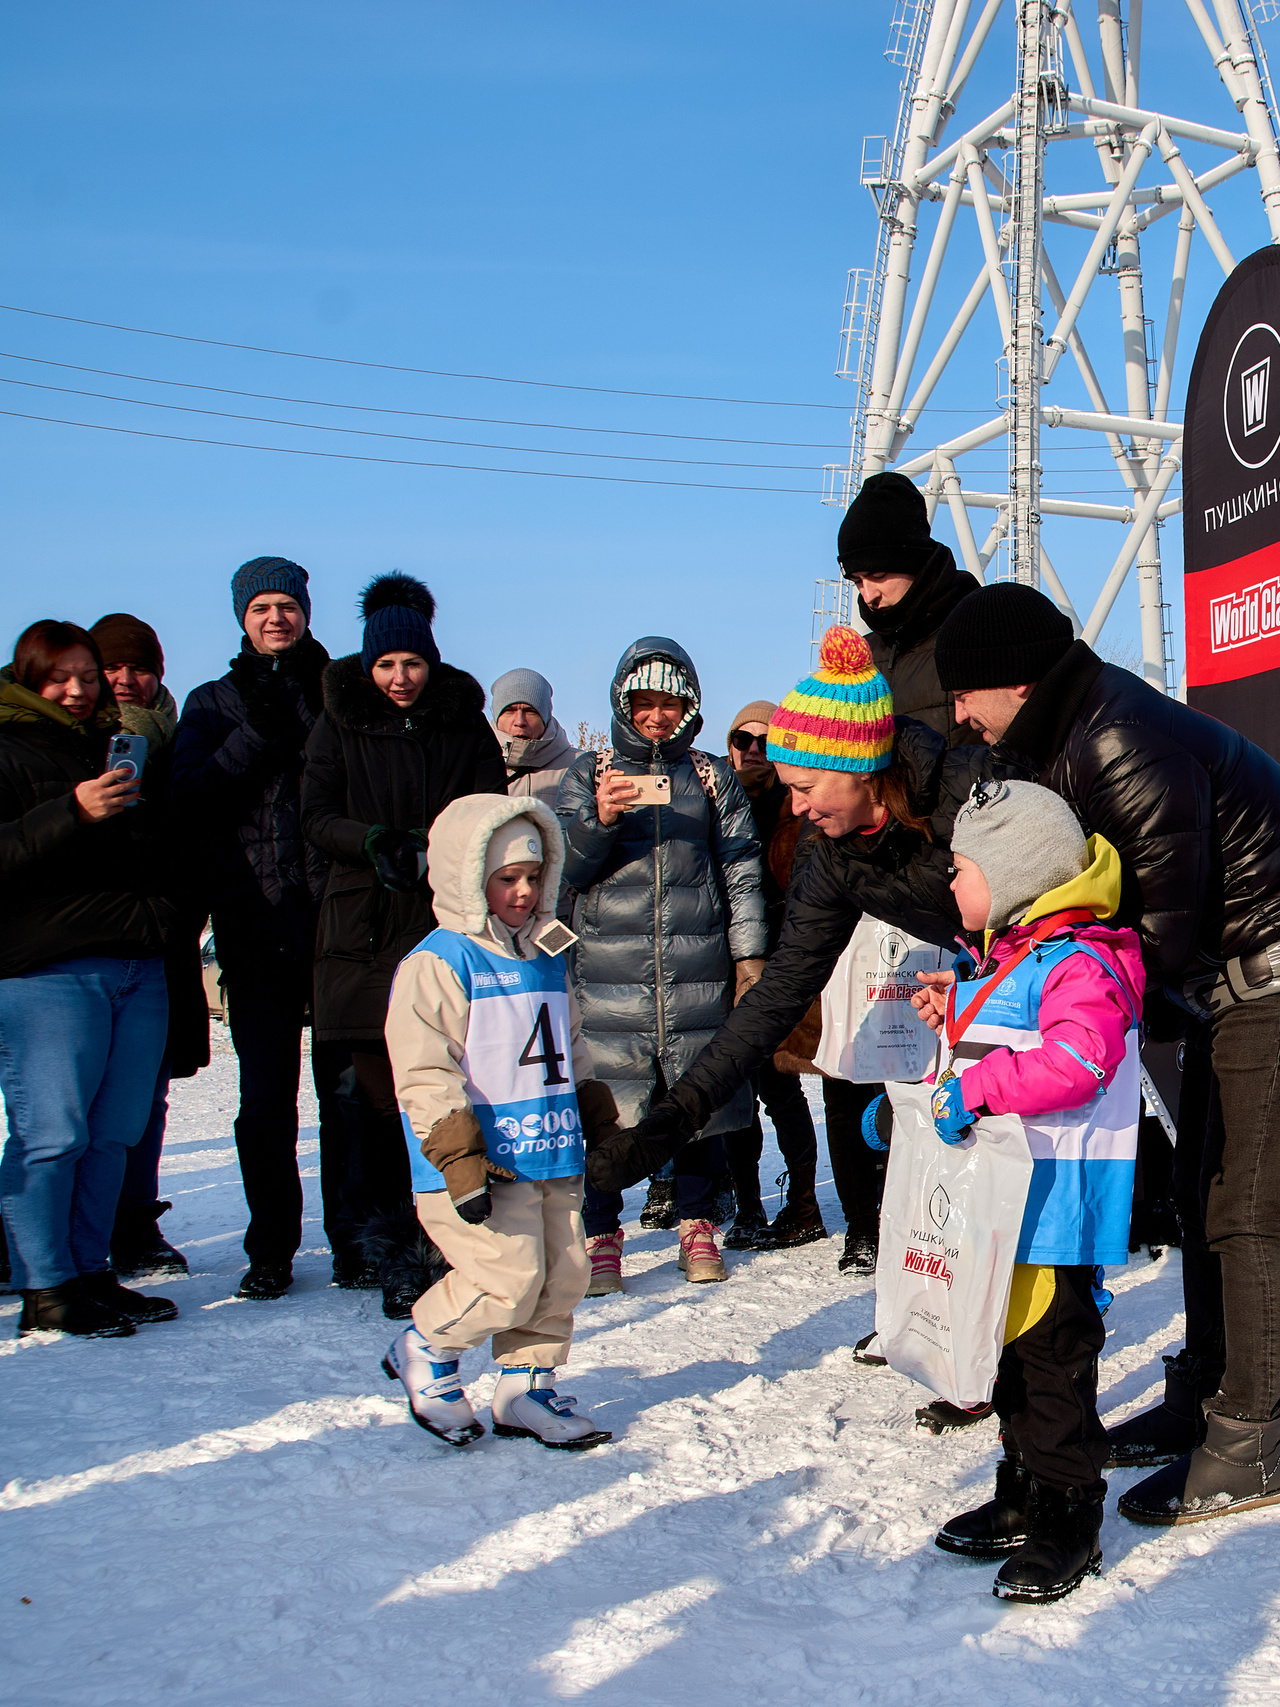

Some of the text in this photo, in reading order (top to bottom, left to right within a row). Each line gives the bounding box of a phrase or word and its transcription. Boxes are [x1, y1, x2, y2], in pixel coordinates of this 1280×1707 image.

[1214, 592, 1259, 645] World
[866, 970, 924, 979] ПУШКИНСКИ
[896, 985, 924, 999] Clas
[518, 1002, 570, 1086] 4
[496, 1134, 576, 1155] OUTDOOR
[904, 1250, 942, 1275] World
